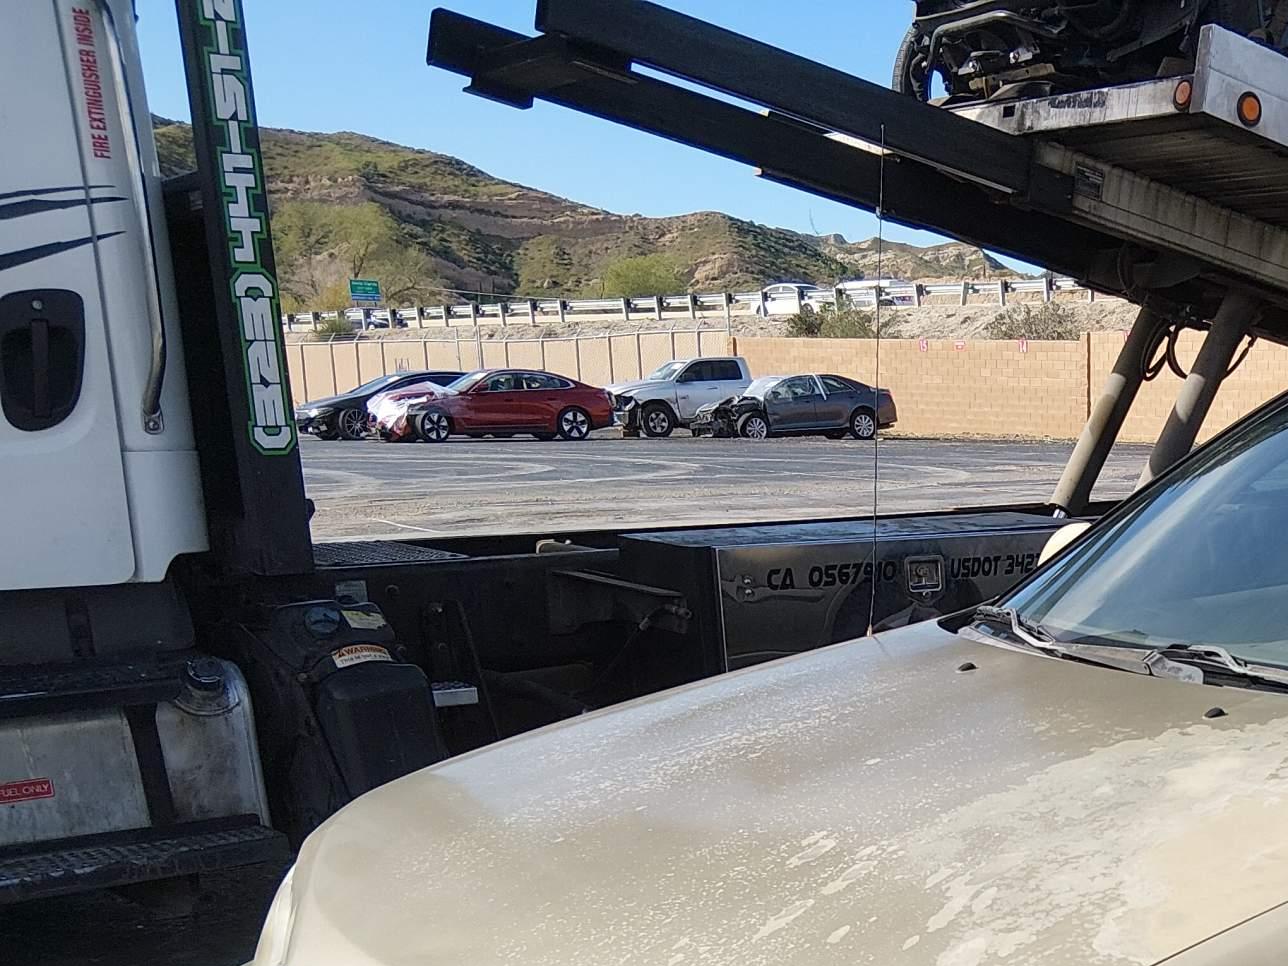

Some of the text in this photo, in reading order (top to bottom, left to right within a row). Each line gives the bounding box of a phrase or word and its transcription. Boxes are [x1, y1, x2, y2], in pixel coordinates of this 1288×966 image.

[72, 7, 112, 160] FIRE EXTINGUISHER INSIDE
[234, 273, 292, 449] (323)
[766, 567, 796, 590] CA
[808, 560, 897, 588] 0567910
[950, 555, 1002, 579] USDOT
[22, 783, 49, 794] ONLY
